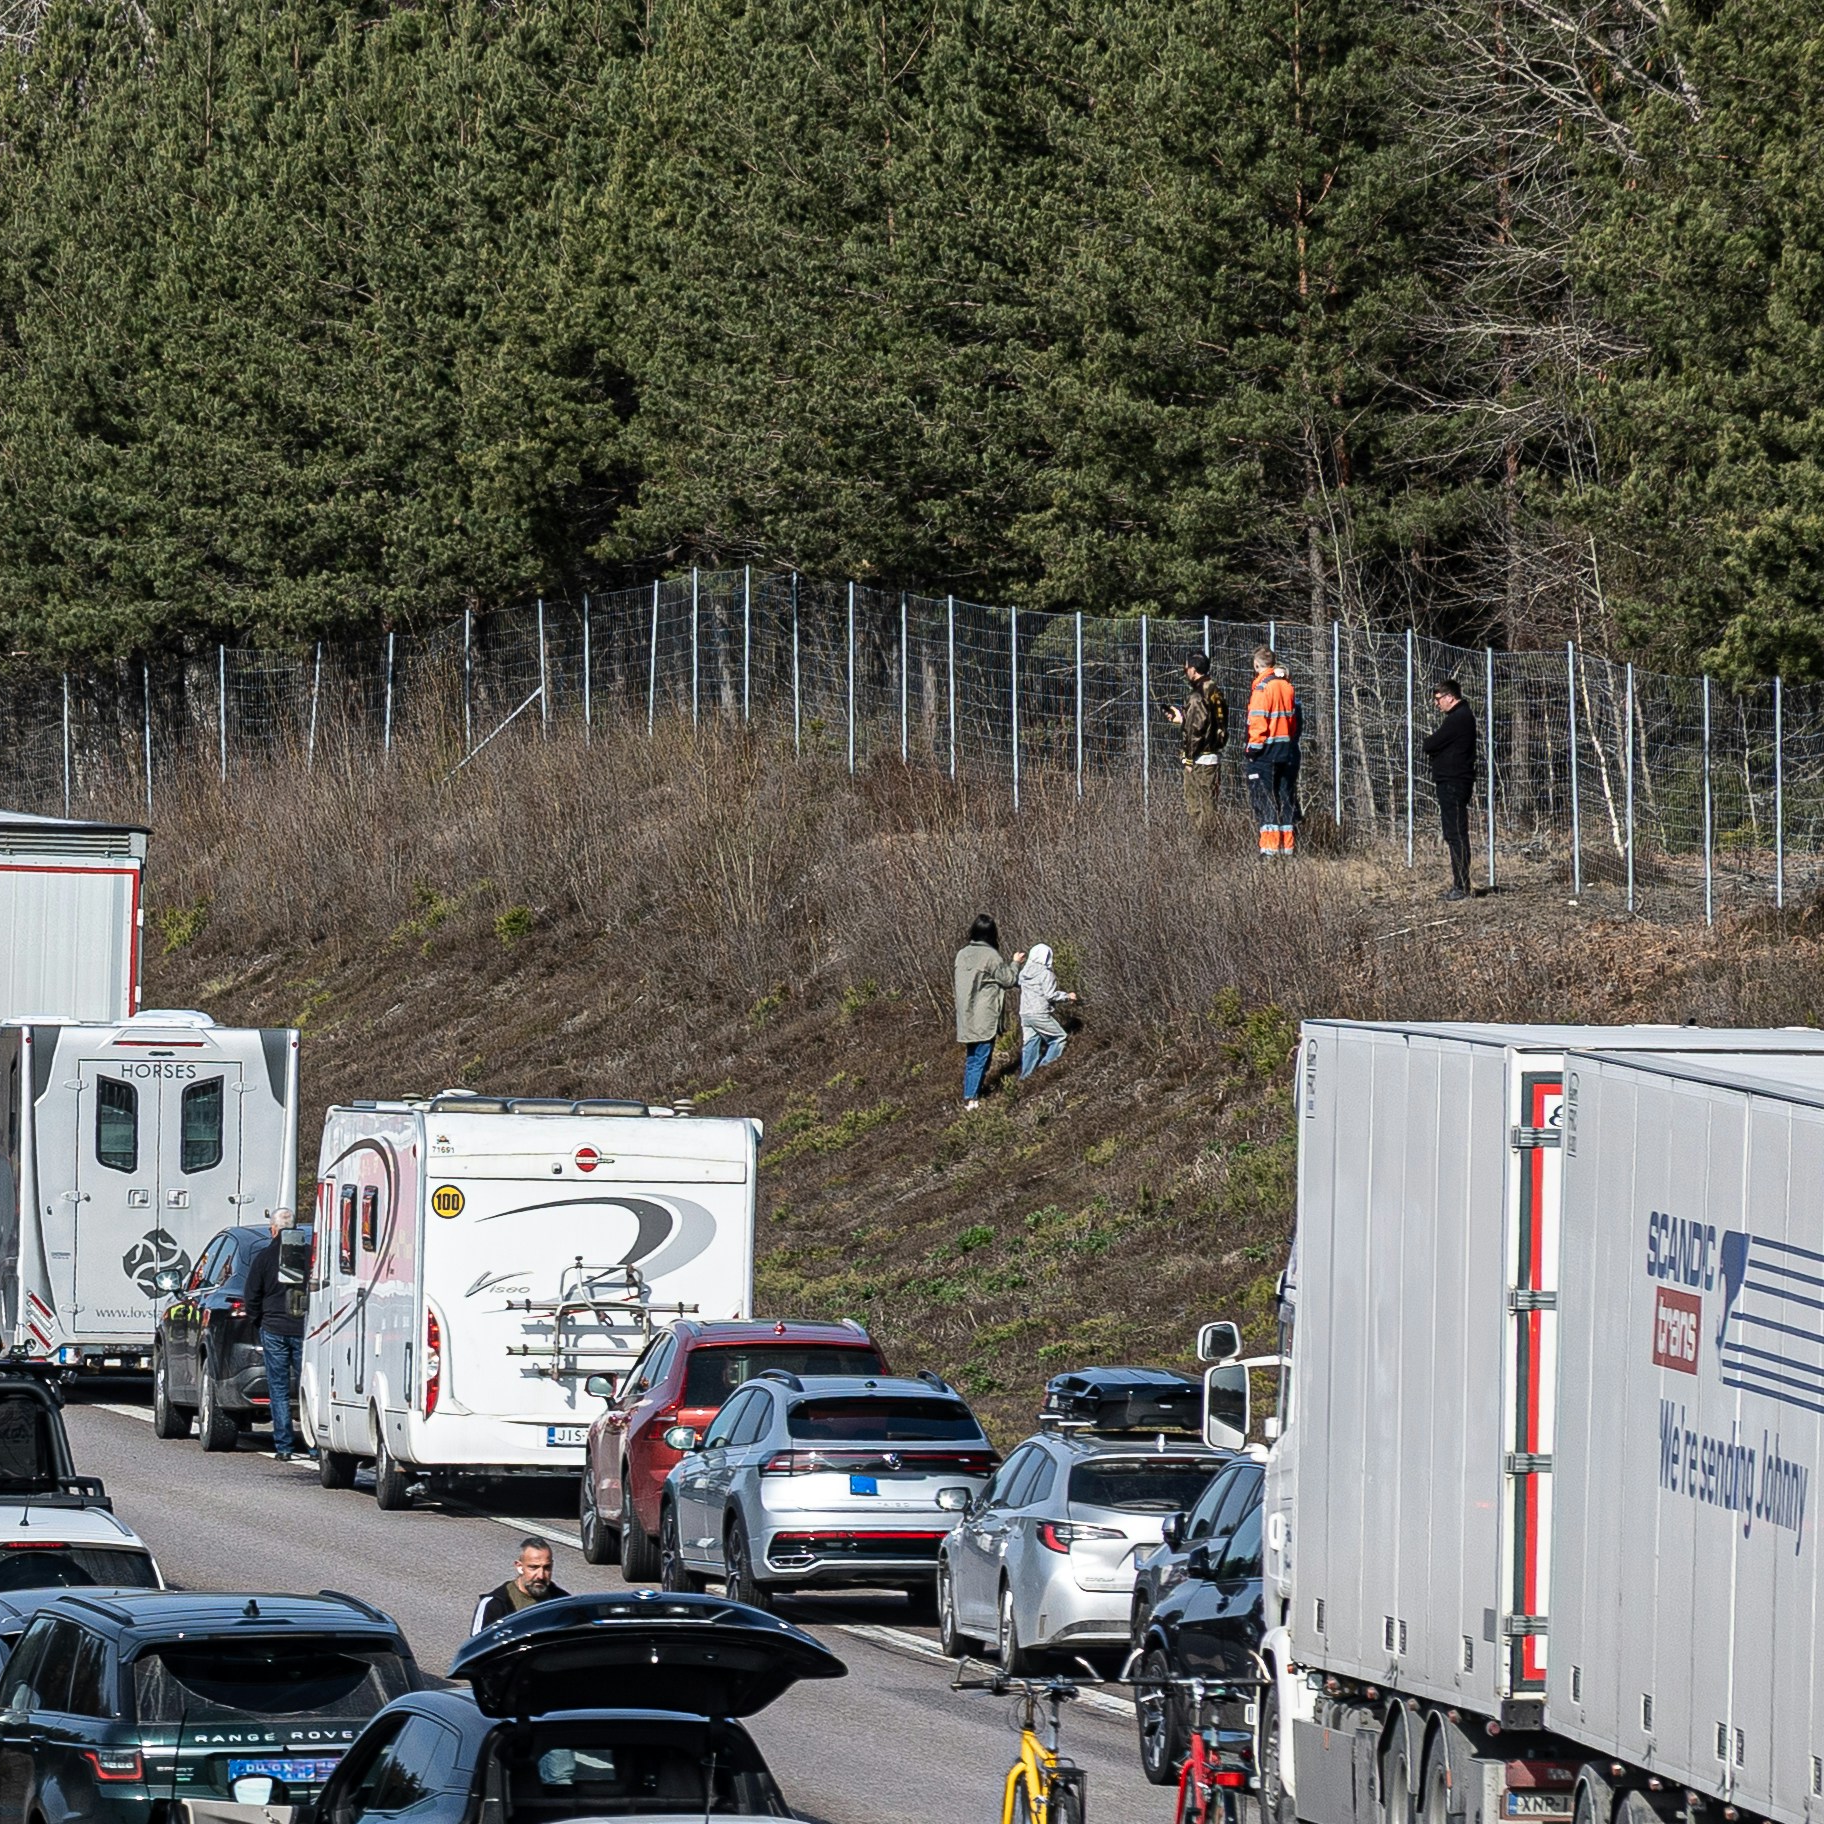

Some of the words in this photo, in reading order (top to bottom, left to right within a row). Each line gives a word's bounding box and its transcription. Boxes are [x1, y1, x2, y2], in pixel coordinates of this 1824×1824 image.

[121, 1064, 196, 1078] HORSES
[436, 1193, 460, 1211] 100
[1647, 1211, 1717, 1292] SCANDIC
[1657, 1296, 1697, 1362] trans
[558, 1429, 589, 1442] JIS-
[1660, 1399, 1699, 1499] We're
[1699, 1420, 1756, 1540] sending
[1756, 1429, 1809, 1557] Johnny
[194, 1732, 277, 1743] RANGE
